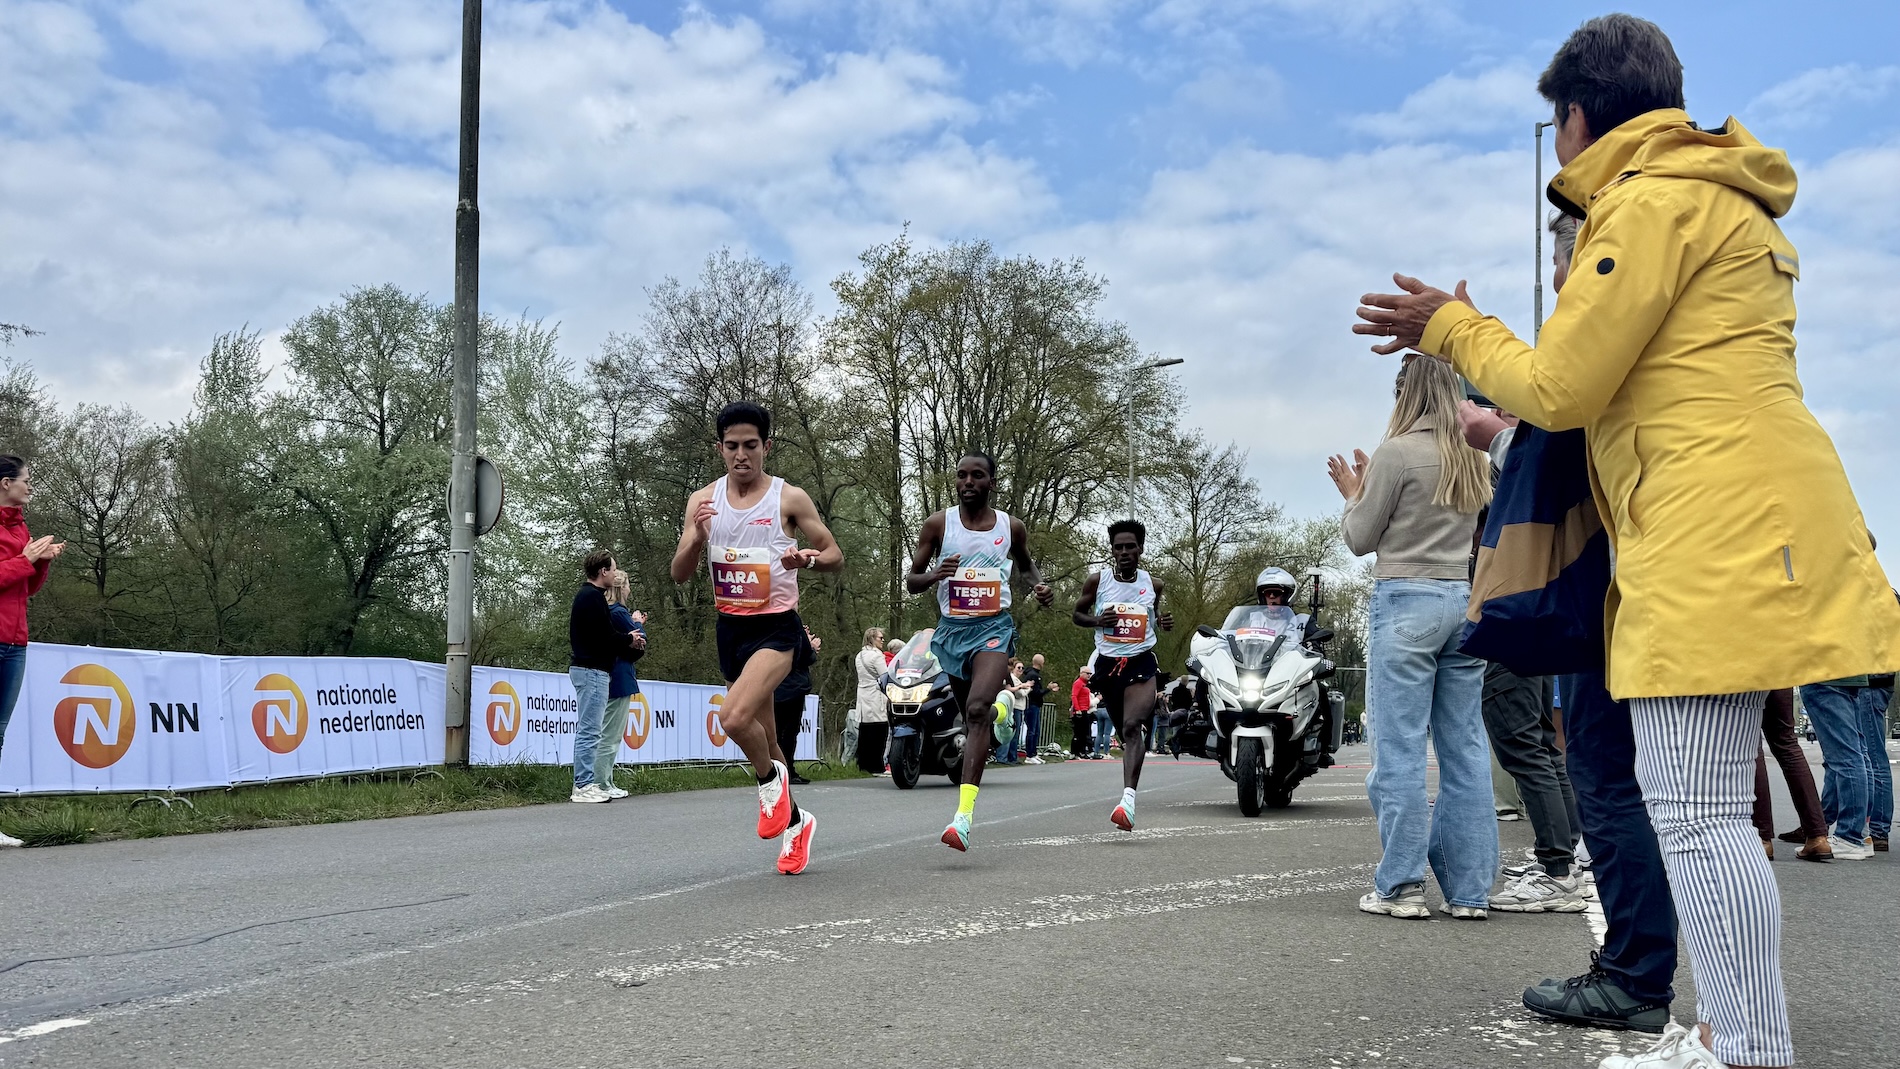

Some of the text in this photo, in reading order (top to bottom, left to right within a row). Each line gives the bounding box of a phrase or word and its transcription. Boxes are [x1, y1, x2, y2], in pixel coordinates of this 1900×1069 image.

[717, 569, 760, 584] LARA
[730, 584, 744, 594] 26
[953, 586, 996, 598] TESFU
[968, 598, 980, 606] 25
[1116, 618, 1142, 628] ASO
[1287, 622, 1305, 632] 24
[1119, 627, 1130, 635] 20
[316, 683, 397, 706] nationale
[527, 693, 577, 712] nationale
[148, 702, 200, 733] NN
[320, 709, 425, 734] nederlanden
[655, 710, 675, 728] NN
